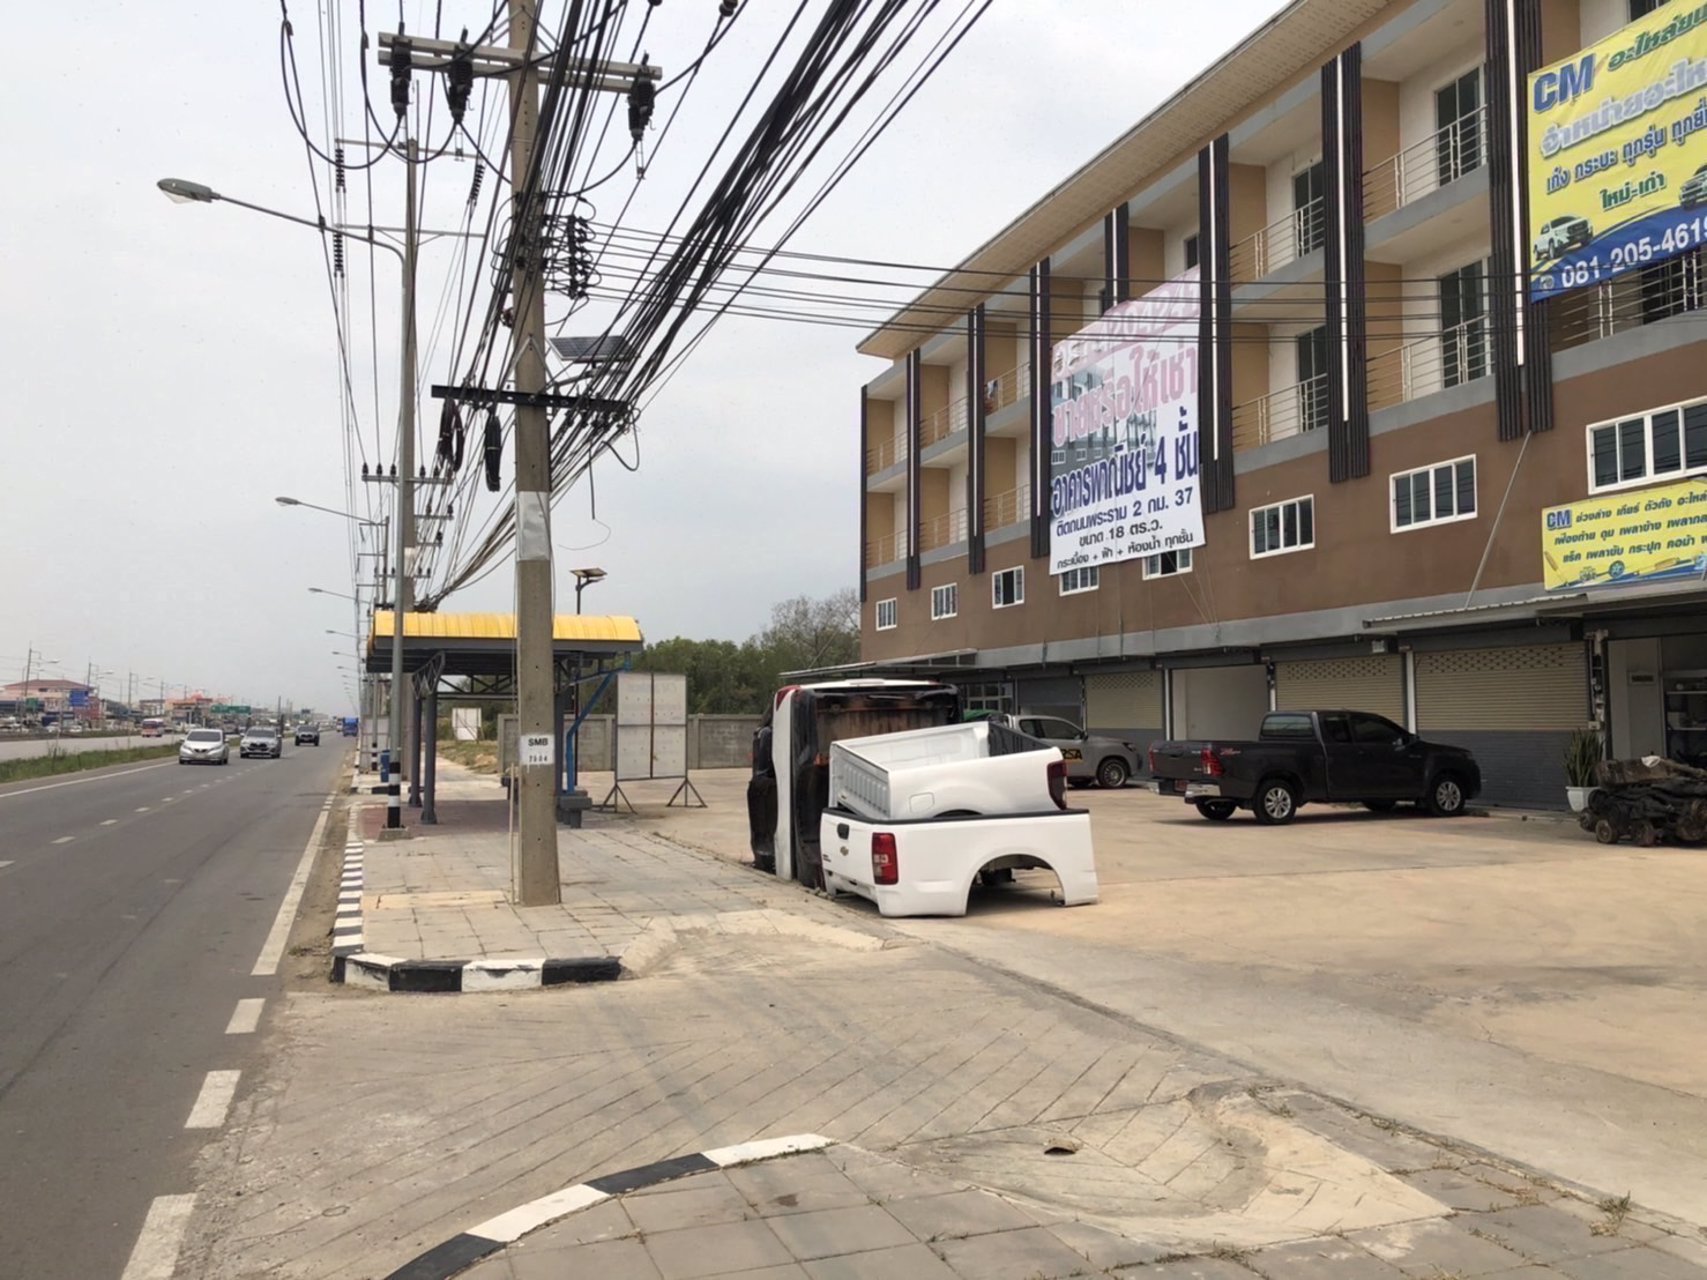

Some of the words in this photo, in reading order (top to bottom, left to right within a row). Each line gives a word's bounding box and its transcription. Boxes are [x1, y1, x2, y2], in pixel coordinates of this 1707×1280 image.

[1534, 53, 1596, 113] CM
[1575, 150, 1618, 182] กระบะ
[1623, 125, 1666, 167] ทุกรุ่น
[1053, 337, 1197, 447] ขายหรือให้เช่า
[1053, 432, 1147, 516] อาคารพาณิชย์
[1154, 436, 1167, 484] 4
[1175, 406, 1198, 480] ชั้น
[1057, 505, 1127, 537] ติดถนนพระราม
[1133, 501, 1142, 517] 2
[1148, 496, 1169, 513] กม.
[1175, 487, 1193, 506] 37
[1079, 531, 1104, 547] ขนาด
[1109, 526, 1125, 540] 18
[1547, 509, 1572, 530] CM
[1128, 536, 1161, 554] ห้องน้ำ
[528, 737, 548, 747] SMB
